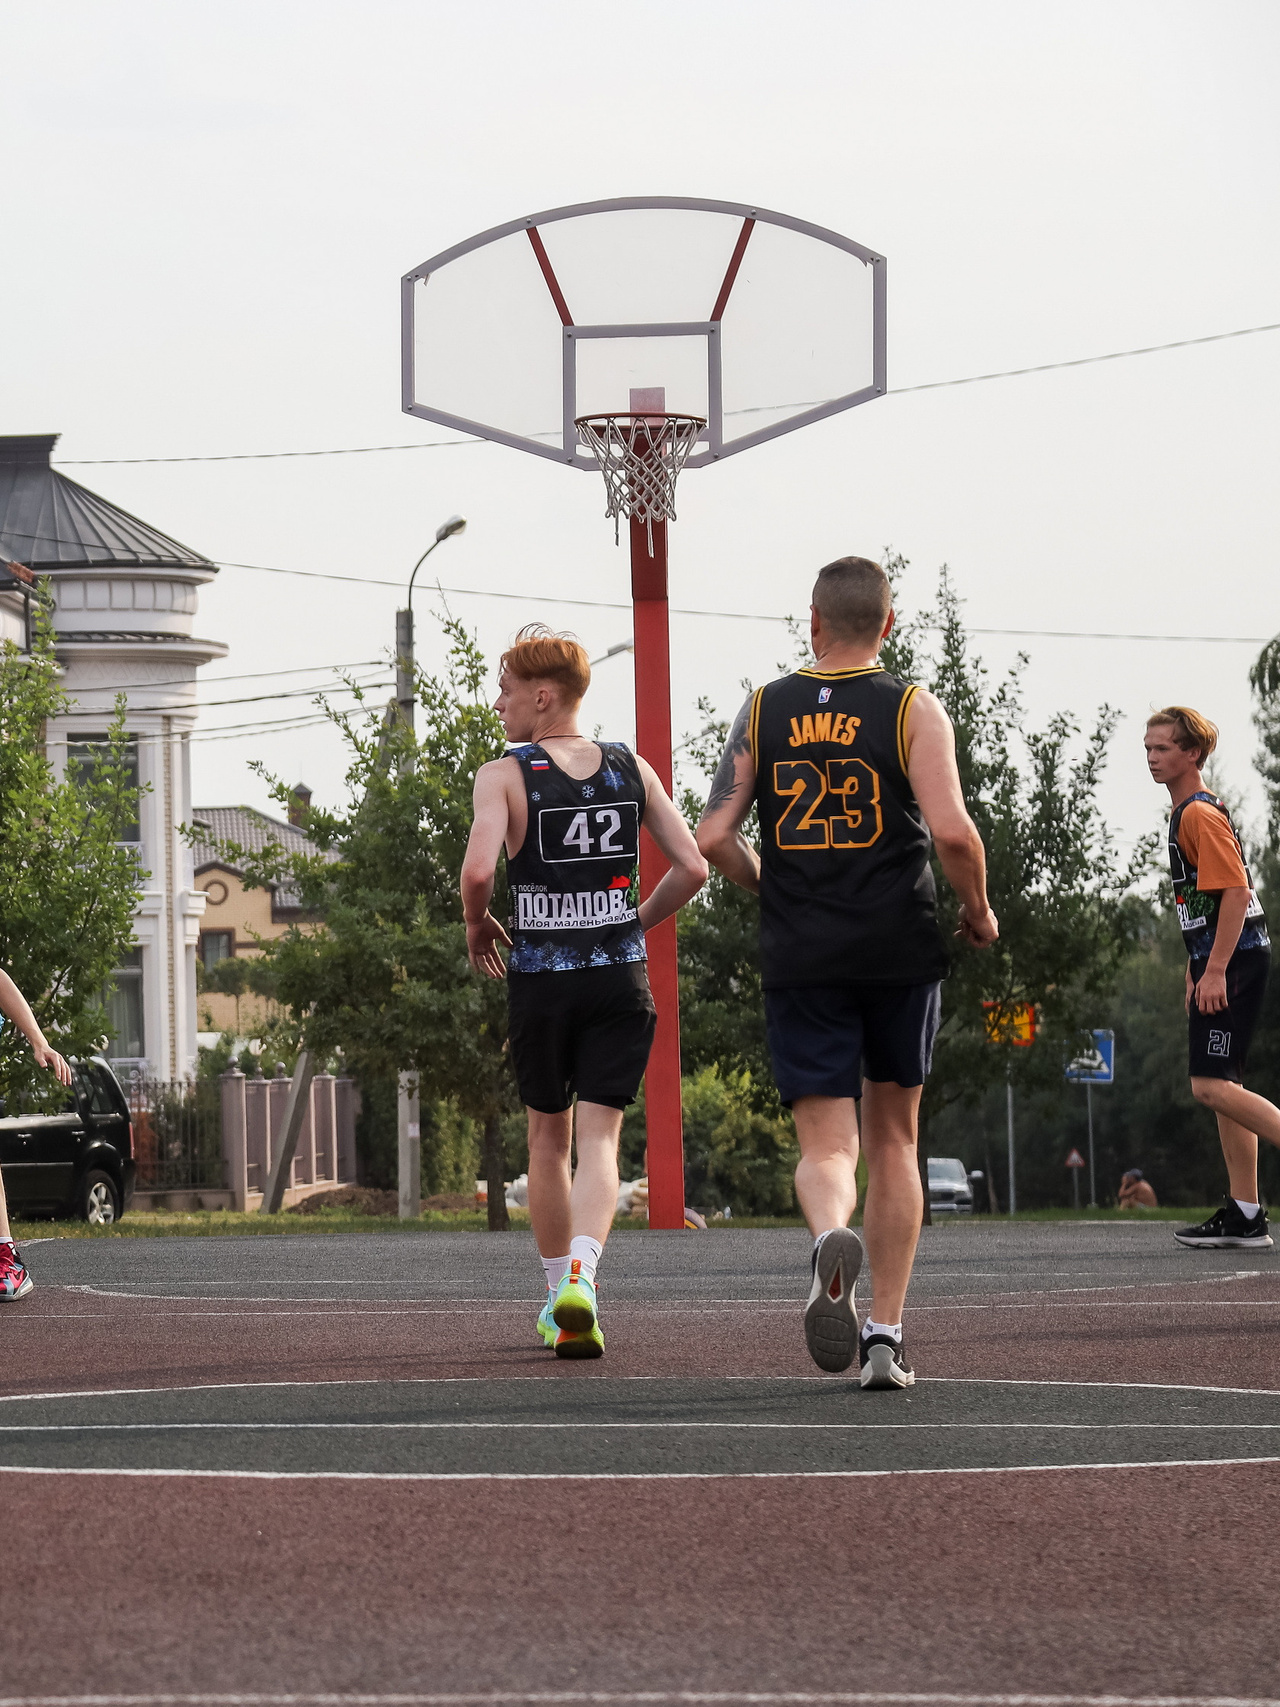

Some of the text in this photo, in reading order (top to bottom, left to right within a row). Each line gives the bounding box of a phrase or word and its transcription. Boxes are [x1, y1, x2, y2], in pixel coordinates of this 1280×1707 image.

[789, 712, 862, 747] JAMES
[773, 758, 883, 850] 23
[562, 809, 624, 854] 42
[523, 919, 550, 928] Моя
[1207, 1029, 1231, 1057] 21
